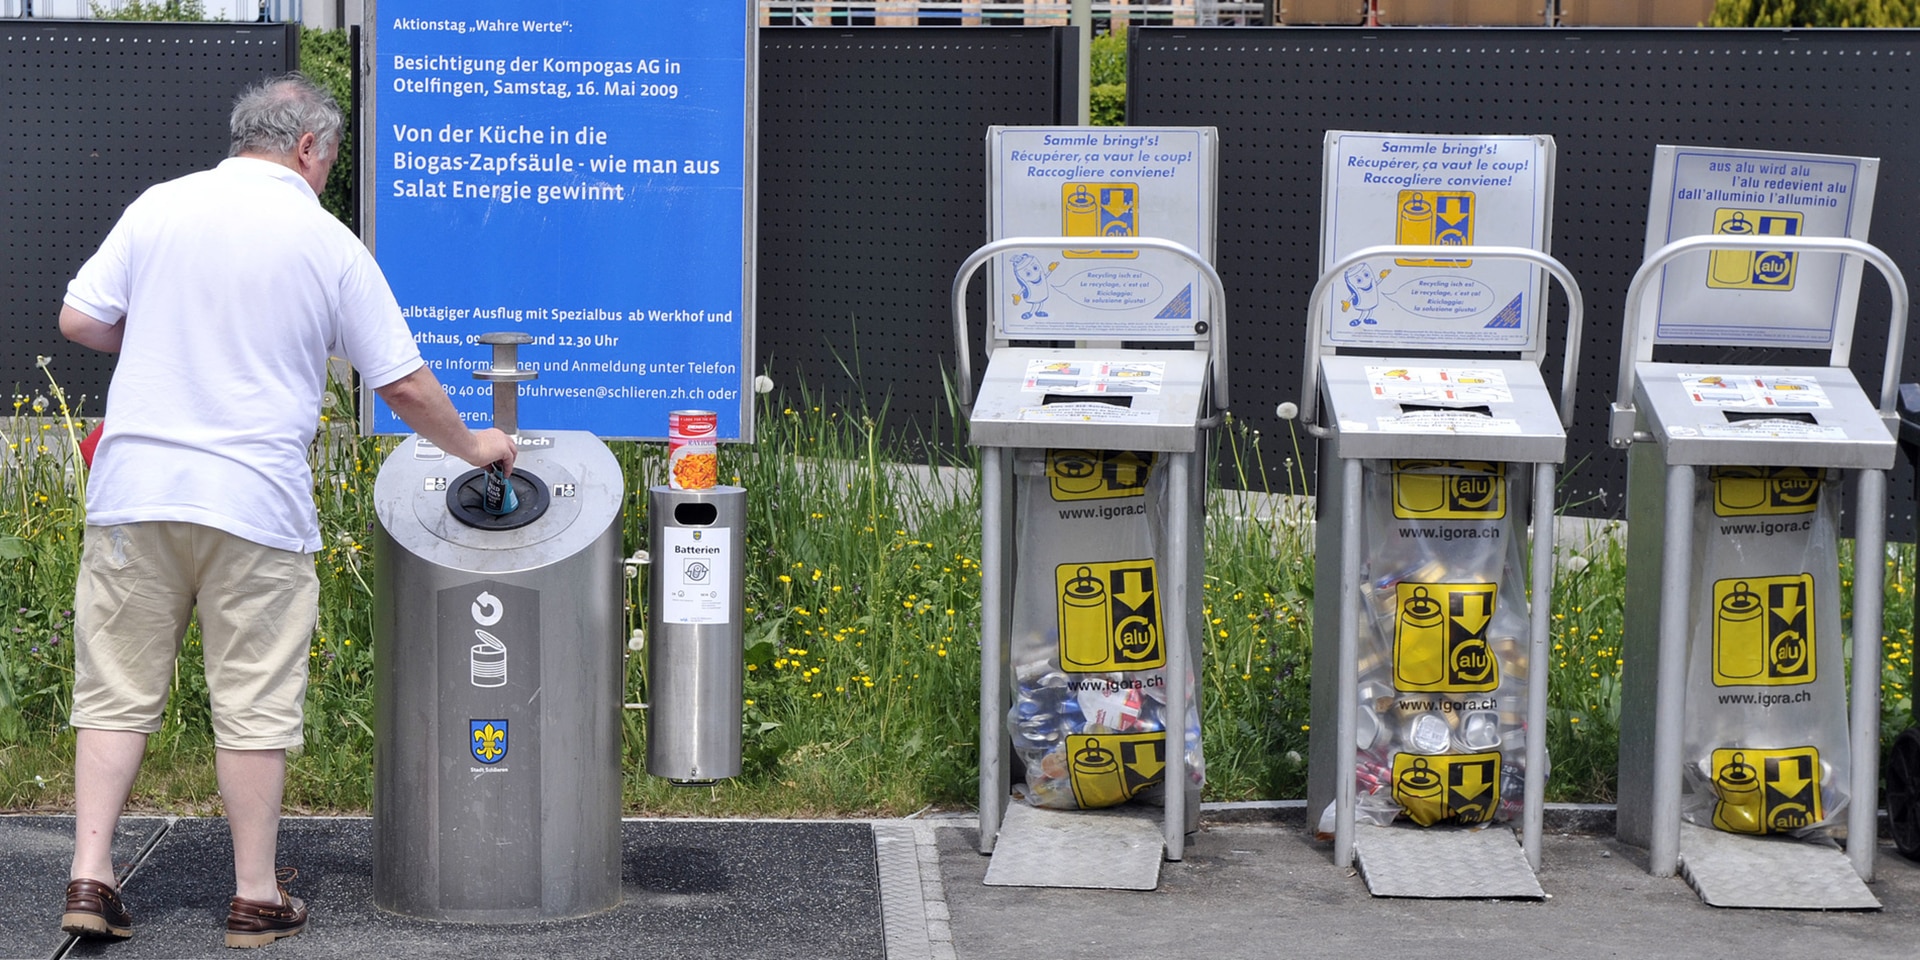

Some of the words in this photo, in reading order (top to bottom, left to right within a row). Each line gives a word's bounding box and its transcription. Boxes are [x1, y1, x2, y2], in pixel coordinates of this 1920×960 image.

[394, 18, 466, 33] Aktionstag
[470, 20, 518, 32] „Wahre
[523, 21, 572, 32] Werte“:
[394, 55, 505, 75] Besichtigung
[510, 56, 538, 71] der
[544, 58, 632, 76] Kompogas
[637, 60, 659, 73] AG
[666, 59, 680, 73] in
[394, 78, 488, 97] Otelfingen,
[494, 80, 571, 98] Samstag,
[577, 81, 599, 95] 16.
[605, 81, 635, 95] Mai
[641, 84, 678, 99] 2009
[393, 125, 432, 142] Von
[439, 124, 473, 142] der
[480, 125, 543, 144] Küche
[551, 126, 568, 144] in
[576, 126, 607, 145] die
[1043, 135, 1098, 146] Sammle
[1103, 135, 1159, 149] bringt's!
[1381, 142, 1437, 154] Sammle
[1442, 142, 1498, 157] bringt's!
[394, 152, 573, 175] Biogas-Zapfsäule
[590, 155, 626, 173] wie
[633, 160, 677, 173] man
[684, 160, 719, 174] aus
[1011, 150, 1083, 164] Récupérer,
[1085, 151, 1100, 165] ça
[1104, 152, 1134, 162] vaut
[1138, 151, 1150, 162] le
[1154, 152, 1192, 165] coup!
[1348, 156, 1420, 170] Récupérer,
[1422, 158, 1438, 172] ça
[1442, 159, 1473, 170] vaut
[1477, 159, 1488, 170] le
[1492, 160, 1528, 173] coup!
[1027, 166, 1105, 180] Raccogliere
[1110, 167, 1175, 178] conviene!
[1709, 161, 1731, 172] aus
[1736, 162, 1754, 173] alu
[1760, 164, 1786, 175] wird
[1791, 165, 1810, 176] alu
[1364, 173, 1442, 187] Raccogliere
[1448, 174, 1512, 186] conviene!
[1732, 176, 1759, 189] l'alu
[1764, 179, 1823, 192] redevient
[1827, 181, 1847, 193] alu
[394, 179, 446, 197] Salat
[453, 181, 531, 203] Energie
[538, 182, 624, 204] gewinnt
[1678, 188, 1765, 203] dall'alluminio
[1770, 192, 1837, 207] l'alluminio
[1761, 260, 1784, 273] alu
[1419, 280, 1449, 288] Recycling
[473, 307, 522, 322] Ausflug
[526, 308, 548, 319] mit
[552, 309, 622, 322] Spezialbus
[629, 309, 644, 321] ab
[648, 310, 704, 322] Werkhof
[708, 311, 732, 322] und
[532, 334, 554, 345] und
[559, 336, 591, 347] 12.30
[595, 335, 618, 346] Uhr
[544, 360, 568, 371] und
[572, 361, 646, 375] Anmeldung
[650, 363, 685, 373] unter
[688, 362, 735, 373] Telefon
[459, 386, 473, 396] 40
[518, 385, 703, 399] bfuhrwesen@schlieren.zh.ch
[708, 388, 737, 399] oder
[513, 437, 549, 445] lech
[1459, 480, 1486, 495] alu
[1399, 526, 1499, 541] www.igora.ch
[1721, 518, 1812, 536] www.igora.c
[1123, 630, 1148, 646] alu
[1778, 642, 1798, 660] alu
[1459, 653, 1486, 668] alu
[1067, 675, 1163, 693] www.igora.ch
[1399, 698, 1497, 713] www.igora.ch
[1719, 690, 1811, 707] www.igora.ch
[1776, 812, 1806, 827] alu
